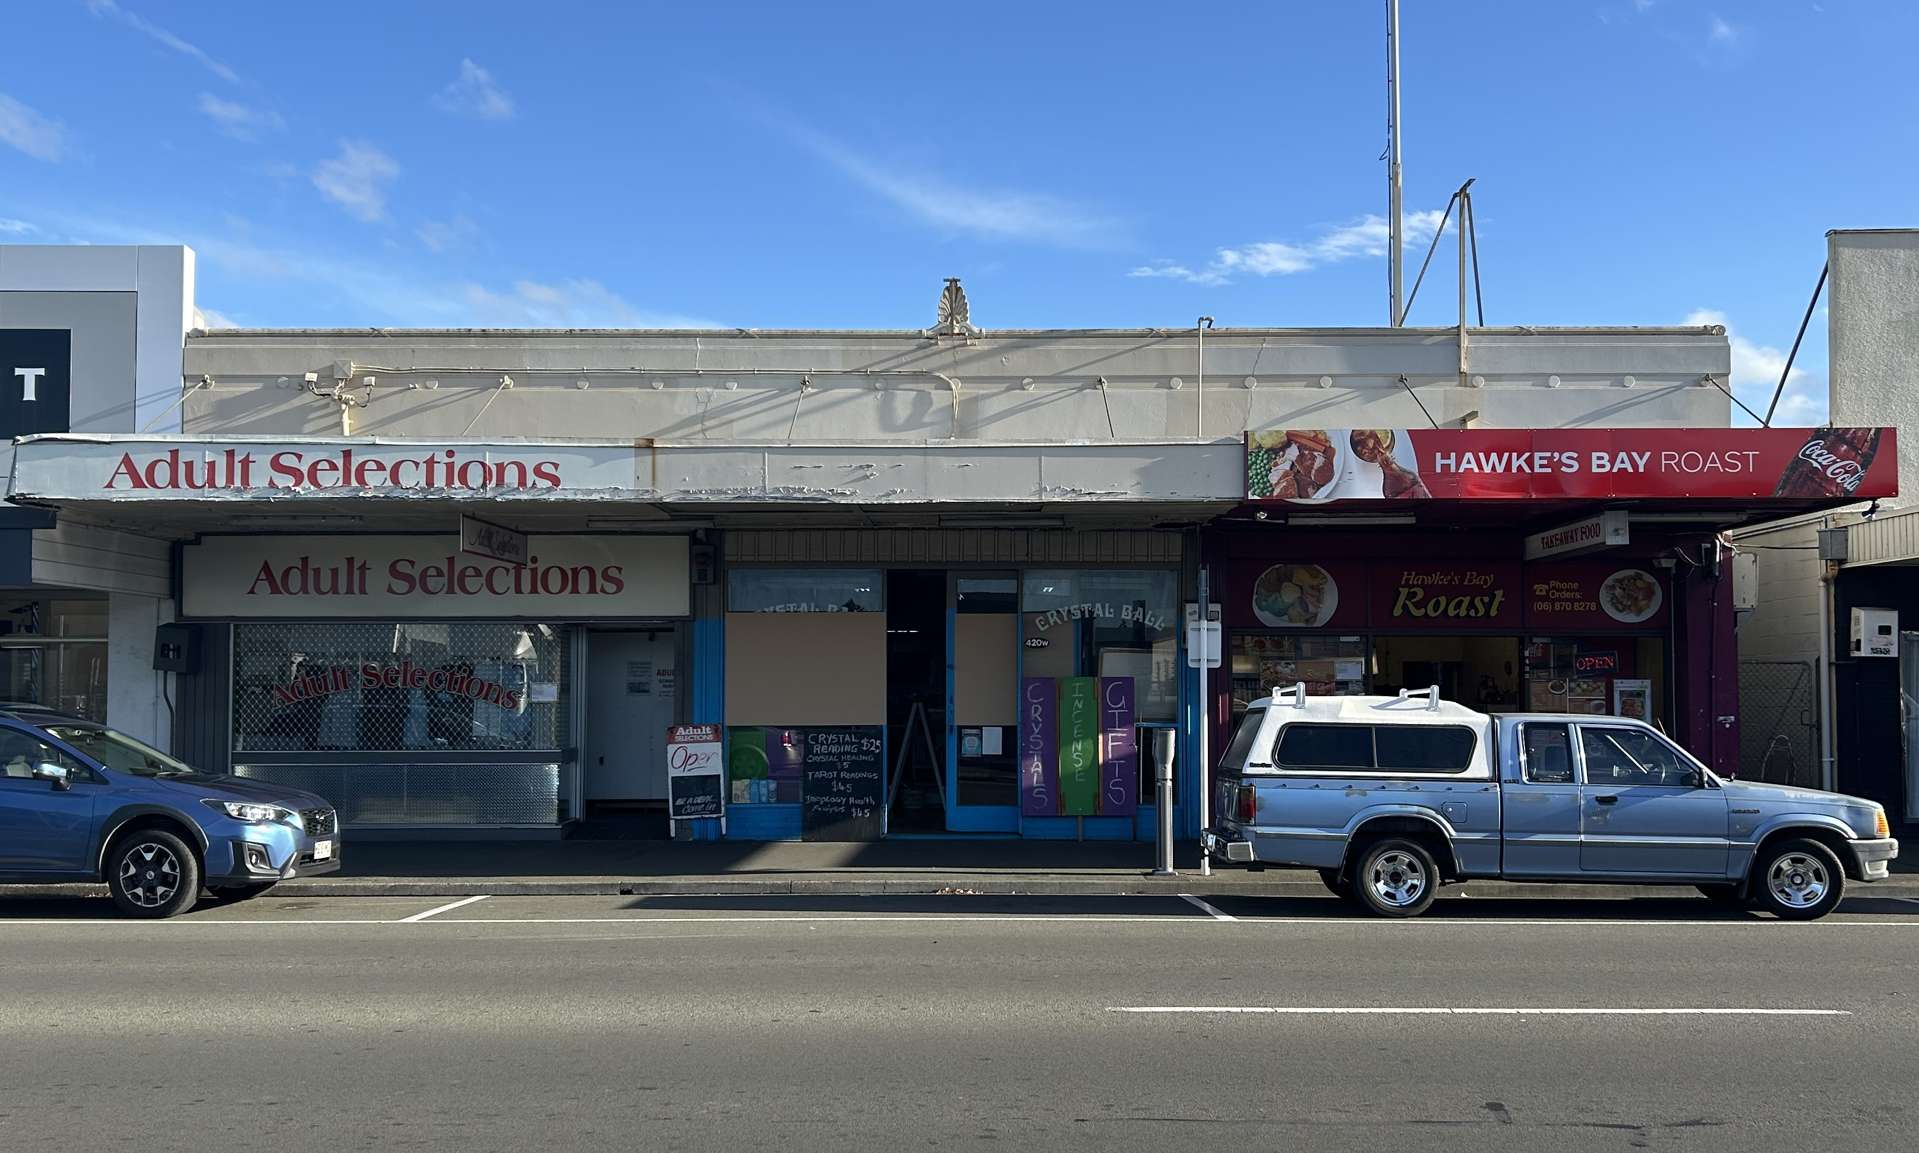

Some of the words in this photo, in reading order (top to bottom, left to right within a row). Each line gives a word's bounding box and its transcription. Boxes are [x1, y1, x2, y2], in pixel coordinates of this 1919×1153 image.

[104, 448, 257, 489] Adult
[268, 449, 562, 490] Selections
[1435, 452, 1580, 473] HAWKE’S
[1592, 452, 1651, 473] BAY
[1661, 452, 1760, 473] ROAST
[1580, 523, 1601, 543] FOOD
[246, 556, 372, 595] Adult
[387, 556, 625, 596] Selections
[1401, 571, 1460, 585] Hawke's
[1463, 571, 1495, 588] Bay
[1549, 580, 1580, 590] Phone
[1393, 587, 1505, 617] Roast
[1548, 590, 1583, 600] Orders:
[1554, 601, 1572, 611] 870
[1035, 603, 1115, 632] CRYSTAL
[1121, 604, 1166, 632] BALL
[1576, 655, 1615, 670] OPEN
[271, 664, 353, 707] Adult
[361, 660, 524, 710] Selections
[676, 726, 713, 736] Adult
[808, 733, 860, 745] CRYSTAL
[1071, 682, 1085, 782] INCENSE
[813, 743, 859, 754] READING
[1027, 682, 1049, 810] CRYSTALS
[1105, 681, 1129, 805] GIFTS
[807, 770, 838, 781] TAROT
